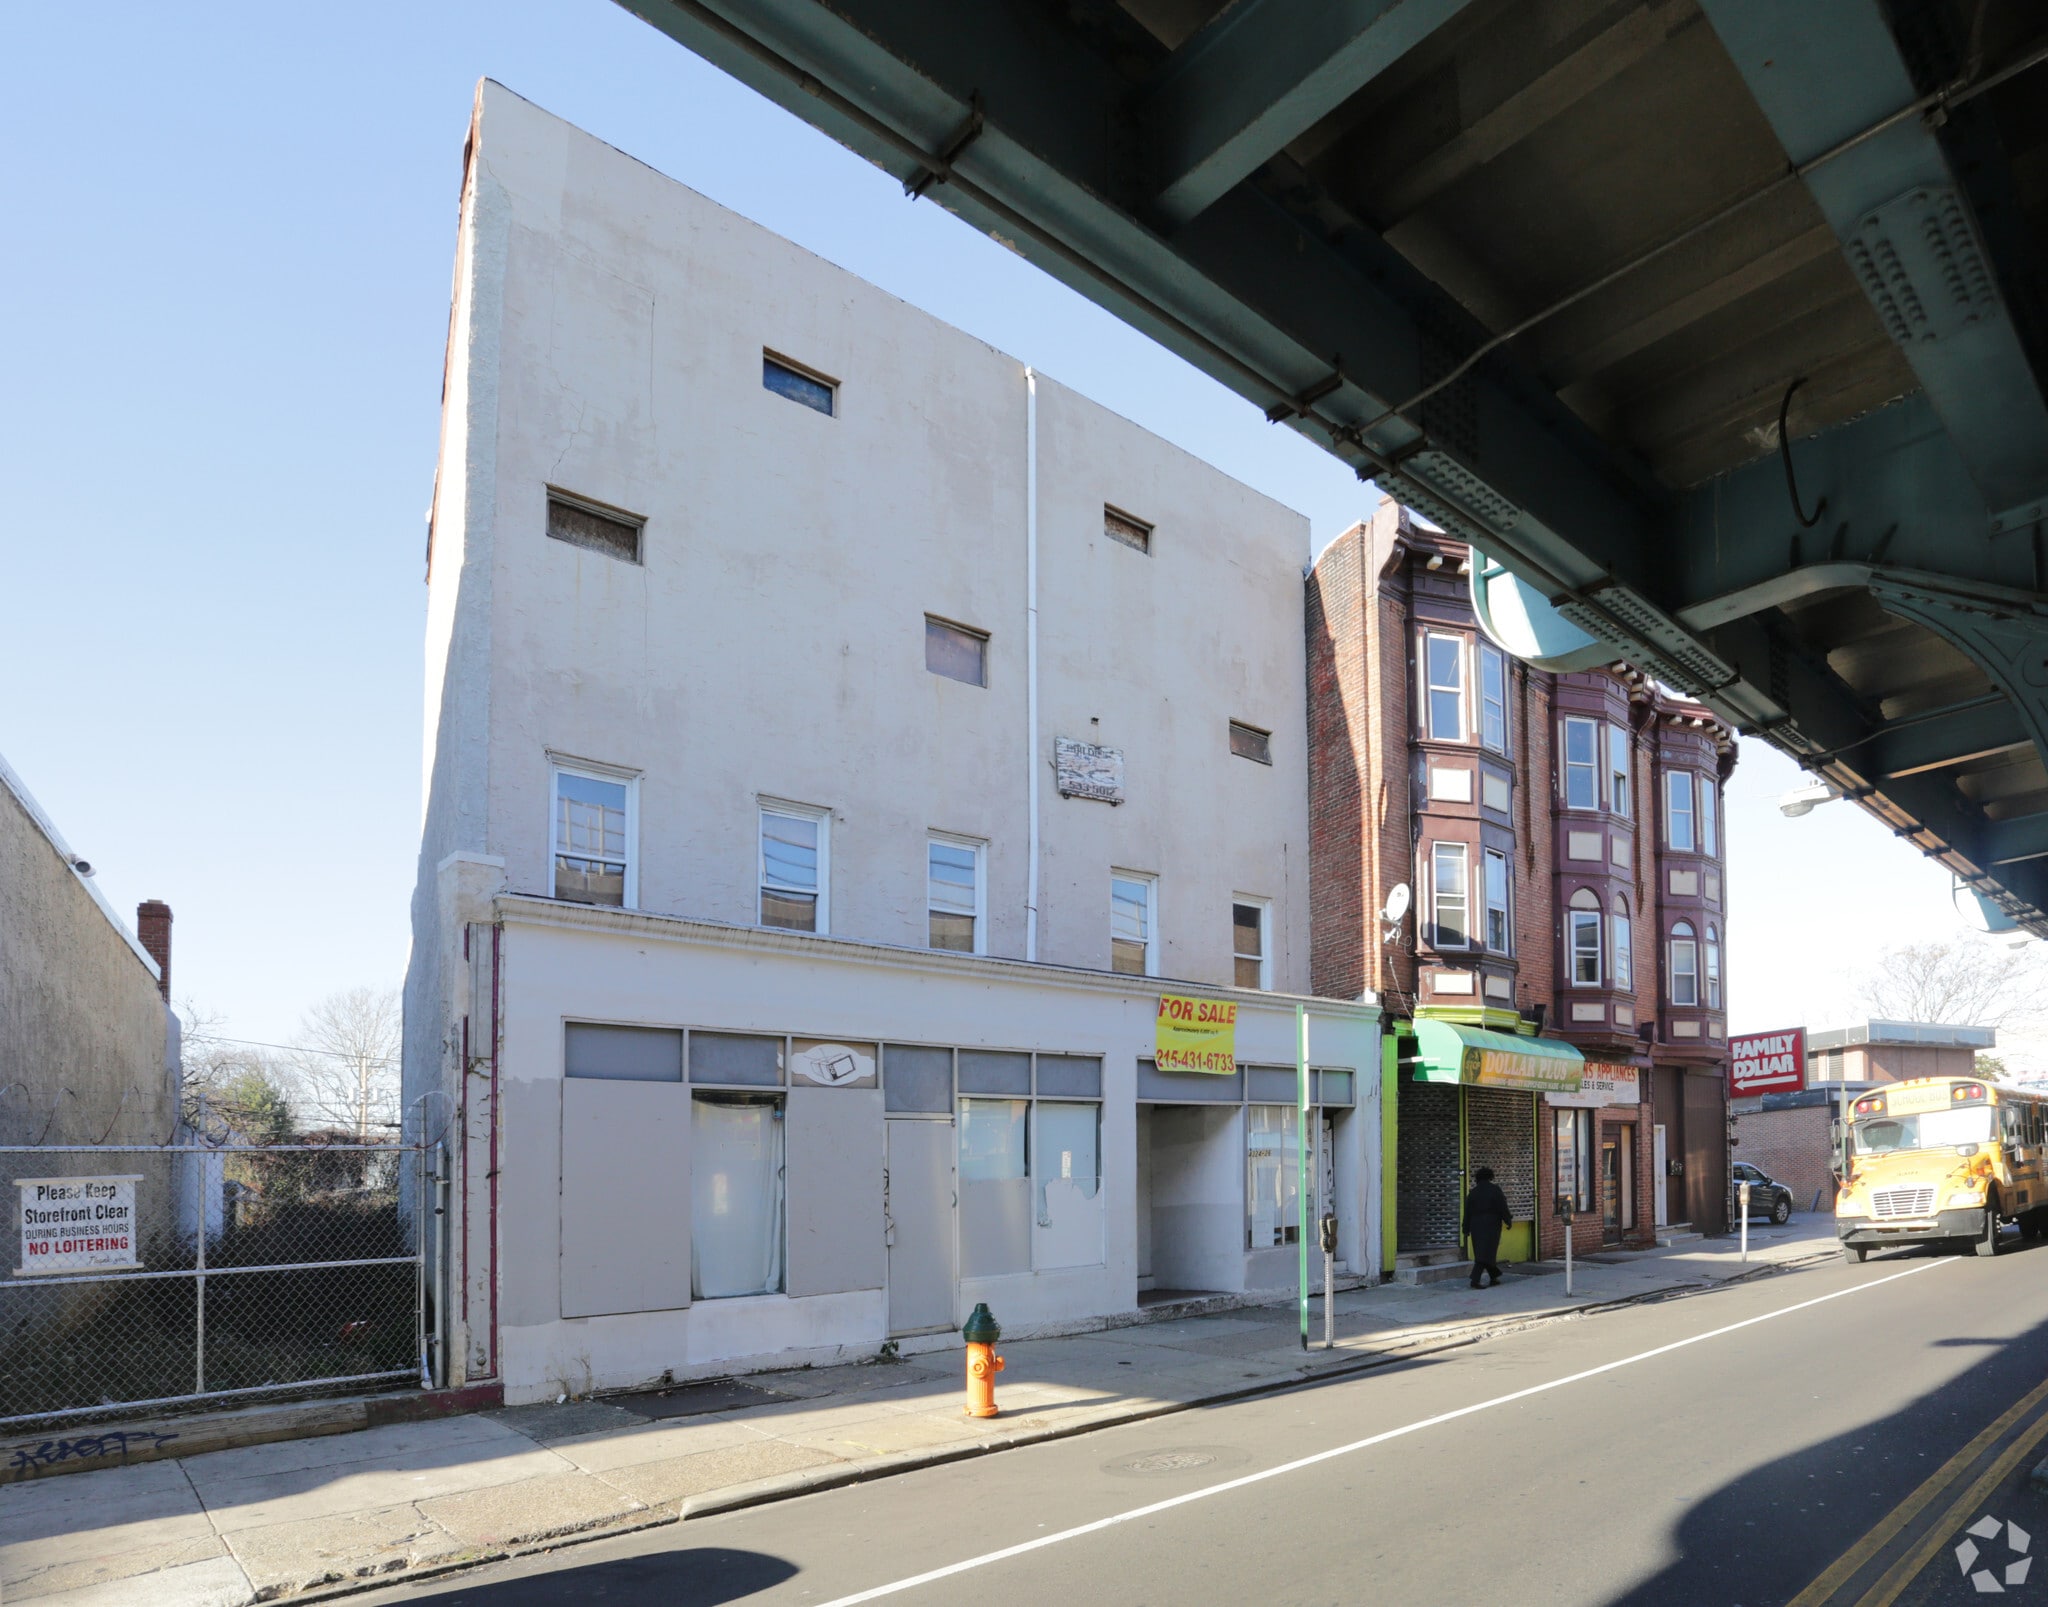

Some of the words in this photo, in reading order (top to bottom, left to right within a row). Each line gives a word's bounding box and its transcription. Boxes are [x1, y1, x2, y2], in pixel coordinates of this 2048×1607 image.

[1158, 998, 1194, 1021] FOR
[1197, 1003, 1236, 1025] SALE
[1732, 1033, 1796, 1060] FAMILY
[1156, 1048, 1235, 1072] 215-431-6733
[1485, 1051, 1536, 1078] DOLLAR
[1538, 1057, 1569, 1081] PLUS
[1733, 1053, 1795, 1079] DOLLAR
[1597, 1063, 1637, 1083] APPLIANCES
[1596, 1081, 1615, 1091] SERVICE
[1891, 1094, 1927, 1107] SCHOOL
[1929, 1089, 1949, 1102] BUS
[37, 1185, 81, 1201] Please
[86, 1183, 116, 1200] Keep
[25, 1206, 92, 1225] Storefront
[96, 1204, 130, 1221] Clear
[25, 1228, 58, 1240] DURING
[60, 1225, 100, 1238] BUSINESS
[102, 1223, 130, 1235] HOURS
[29, 1241, 49, 1256] NO
[55, 1237, 129, 1254] LOITERING
